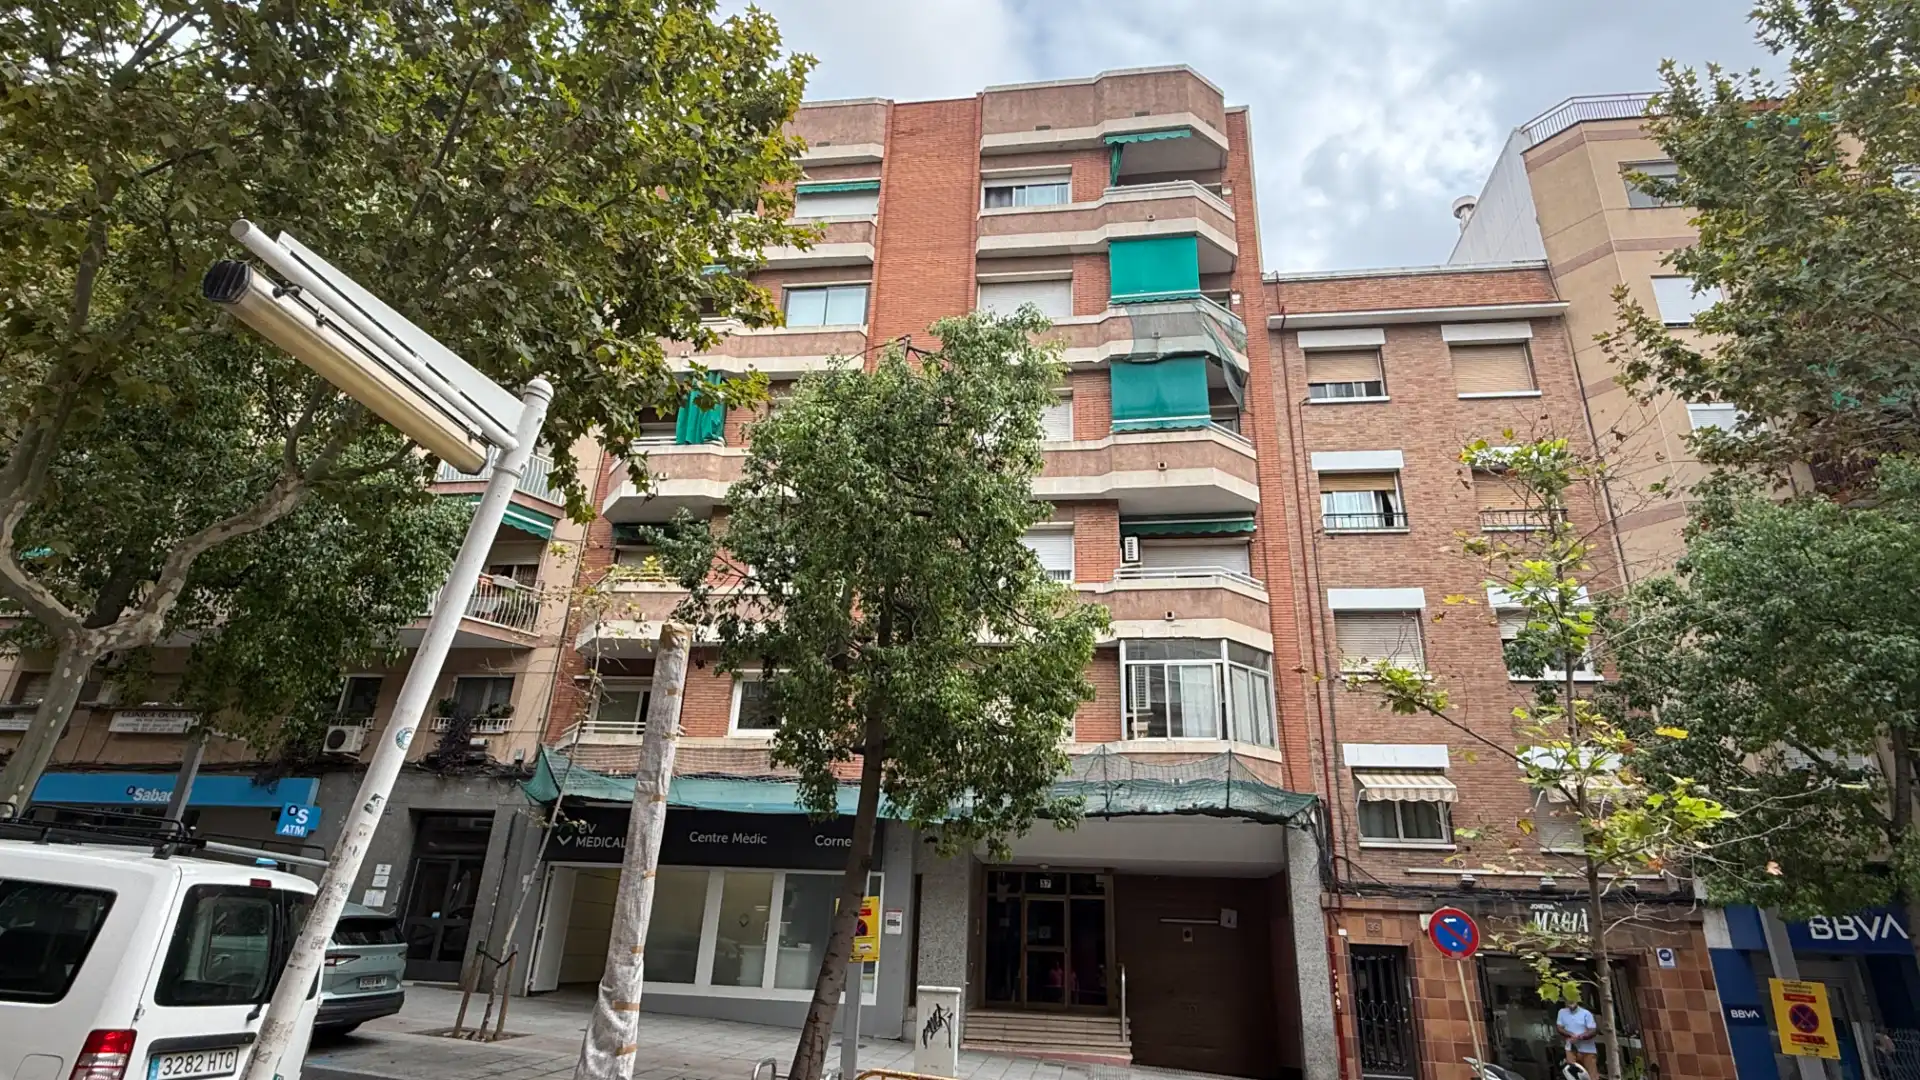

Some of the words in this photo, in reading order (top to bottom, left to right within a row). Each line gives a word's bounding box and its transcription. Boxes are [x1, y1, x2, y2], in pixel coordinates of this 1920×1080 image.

[282, 824, 305, 836] ATM
[575, 836, 627, 849] MEDICAL
[689, 831, 728, 843] Centre
[732, 832, 767, 844] Mèdic
[1808, 913, 1910, 941] BBVA
[1730, 1009, 1760, 1018] BBVA
[162, 1054, 204, 1076] 3282
[207, 1051, 234, 1071] HTC
